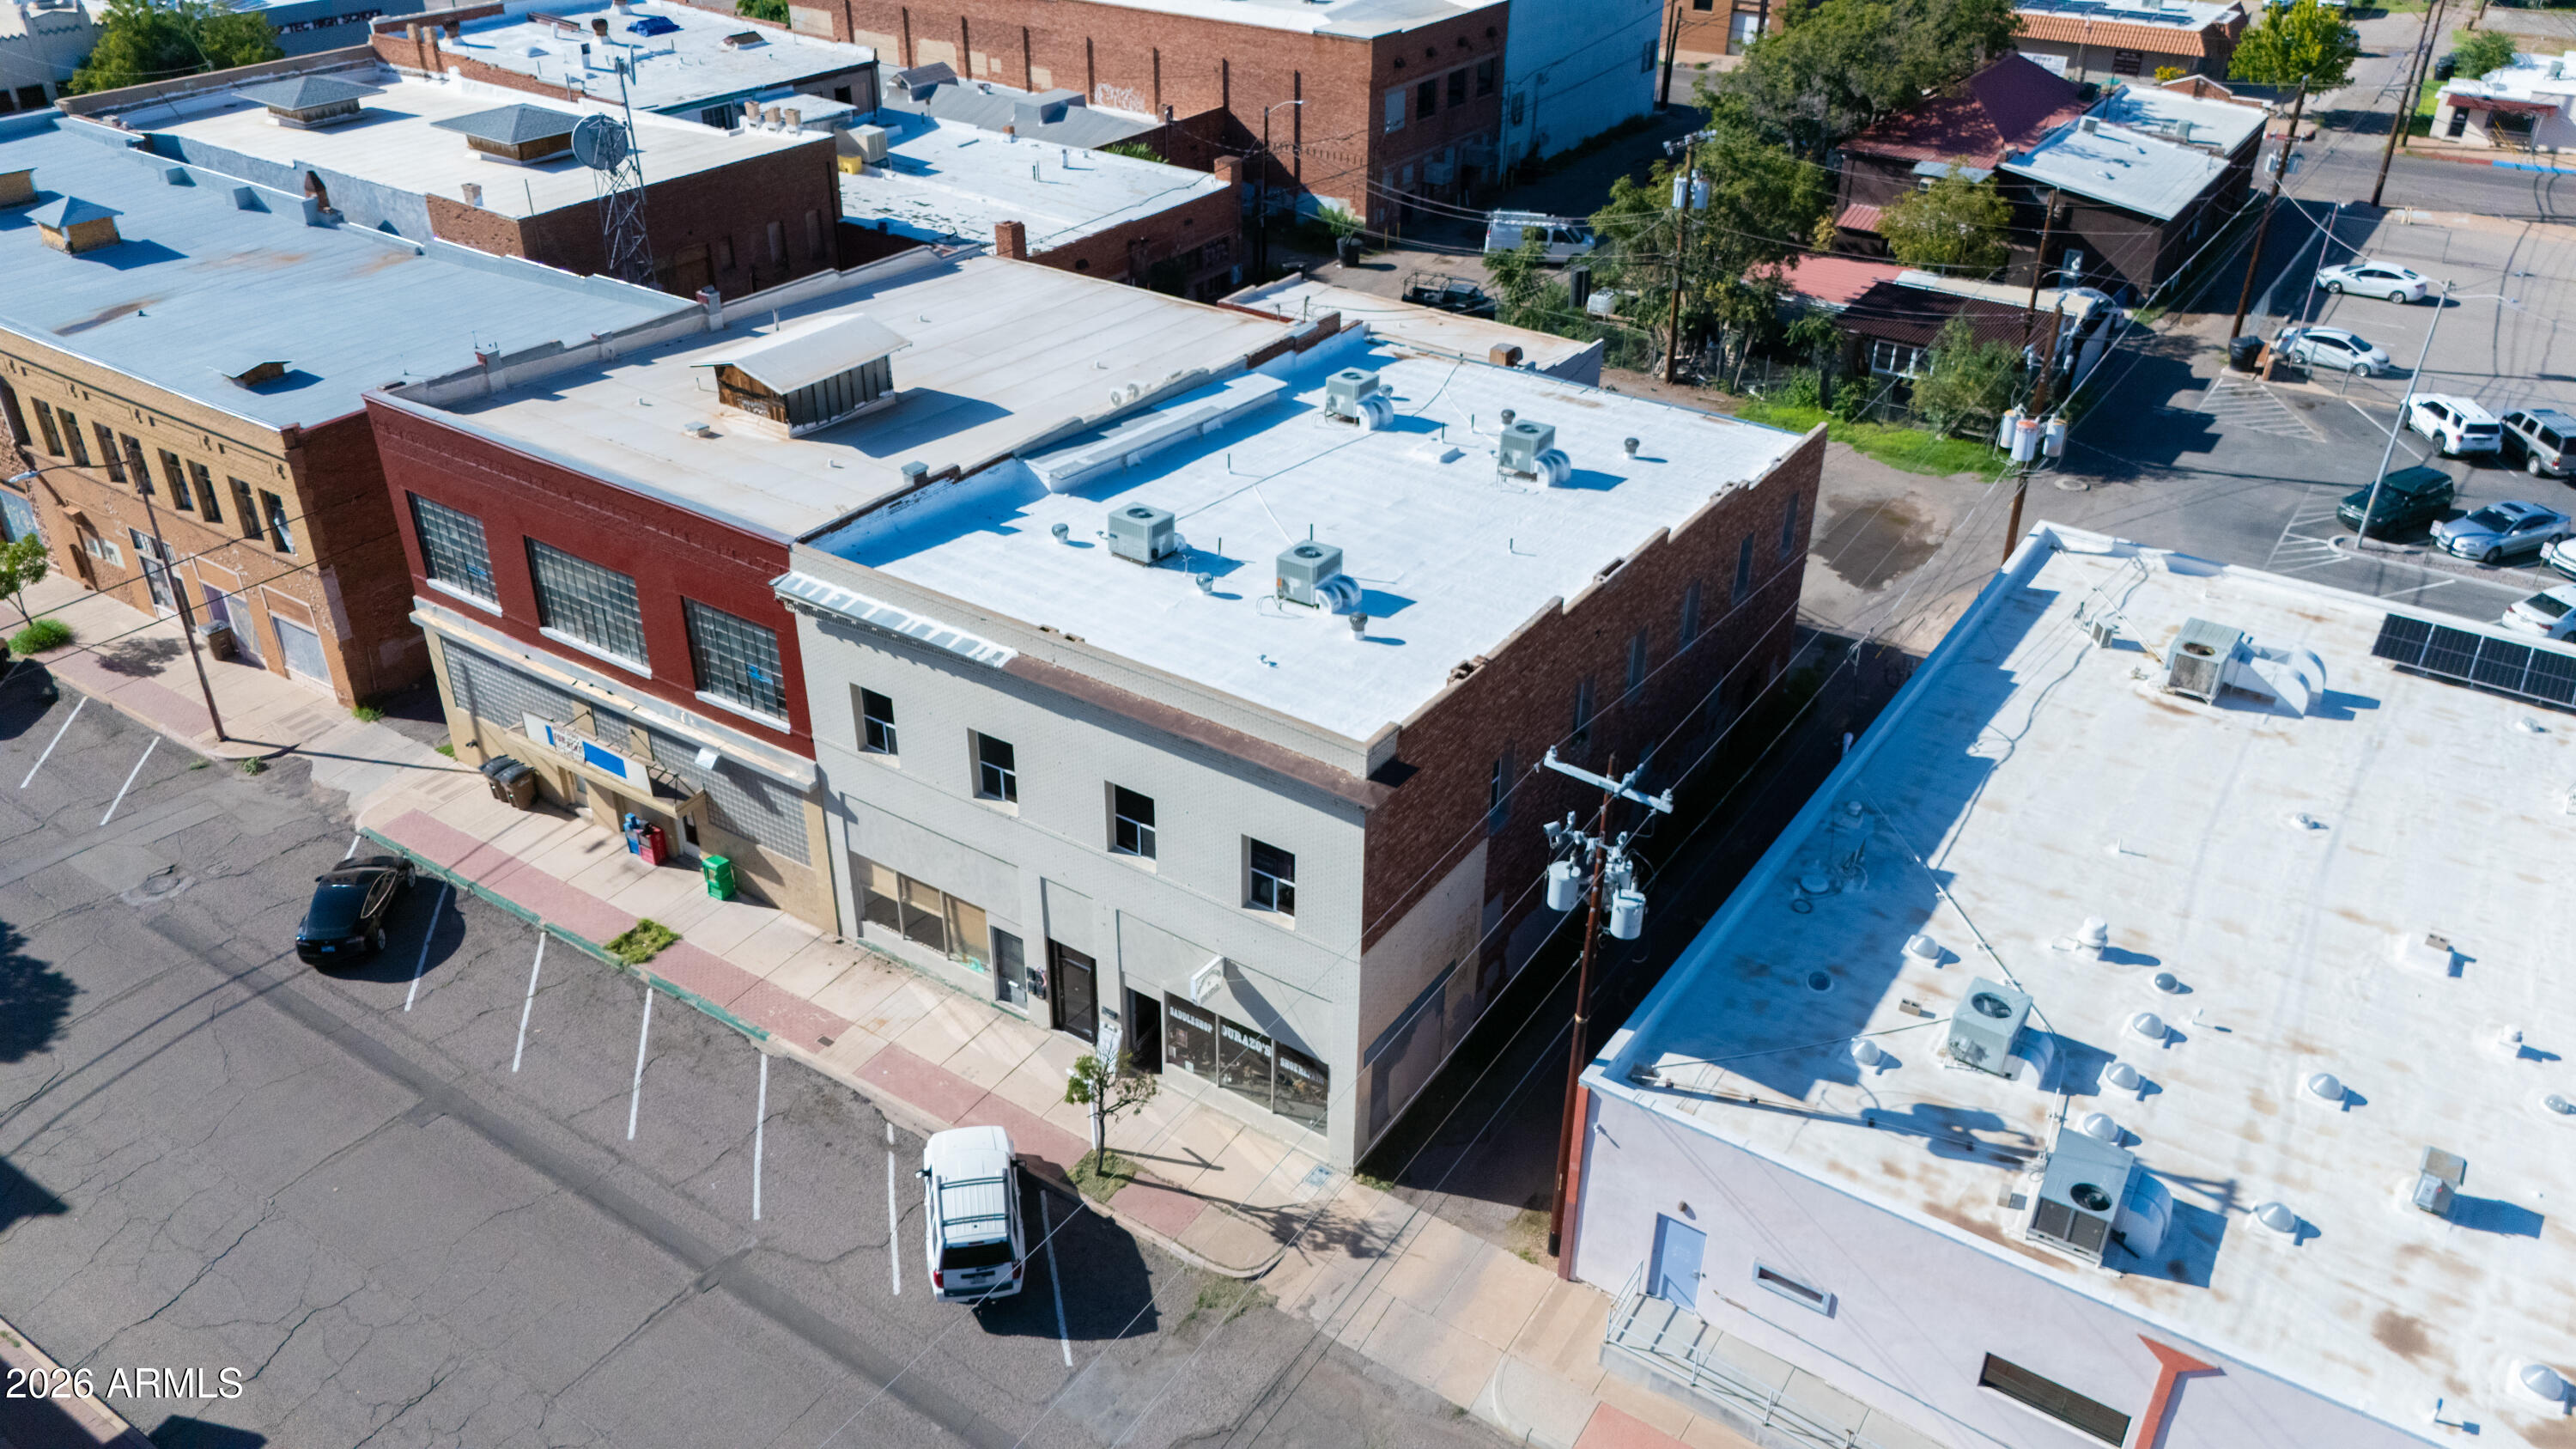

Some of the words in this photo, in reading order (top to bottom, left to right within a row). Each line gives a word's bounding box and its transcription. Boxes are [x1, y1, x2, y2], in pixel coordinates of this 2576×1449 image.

[313, 15, 338, 29] HIGH
[342, 9, 382, 23] SCHOOL
[1220, 1024, 1272, 1058] DURAZO'S
